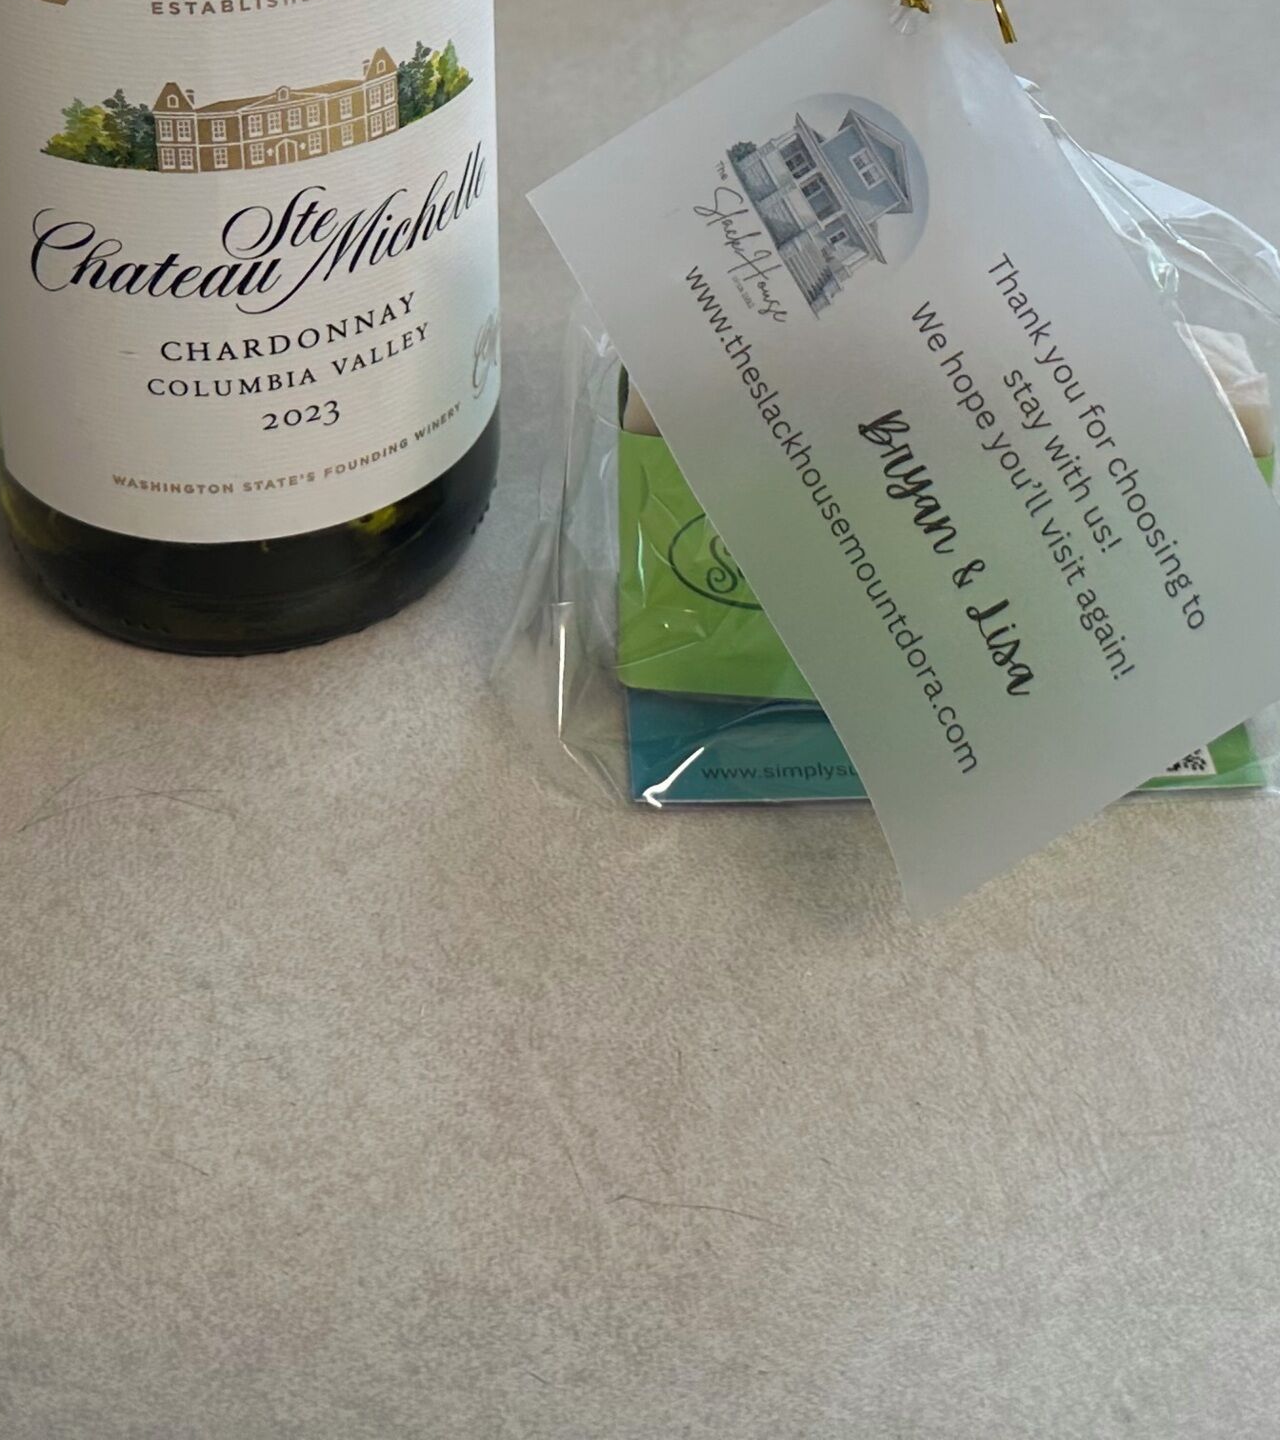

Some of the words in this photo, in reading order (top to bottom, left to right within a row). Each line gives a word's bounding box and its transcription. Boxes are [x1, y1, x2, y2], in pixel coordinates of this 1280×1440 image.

[31, 208, 282, 298] Chateau
[222, 185, 339, 260] Ste
[160, 291, 416, 362] CHARDONNAY
[727, 249, 788, 323] House
[147, 367, 318, 398] COLUMBIA
[331, 322, 430, 376] VALLEY
[111, 473, 235, 495] WASHINGTON
[242, 471, 317, 492] STATE'S
[323, 438, 410, 479] FOUNDING
[413, 401, 462, 442] WINERY
[262, 400, 341, 431] 2023
[988, 252, 1052, 346] Thank
[1034, 345, 1086, 403] you
[1078, 404, 1116, 449] for
[1108, 457, 1192, 598] choosing
[1181, 593, 1205, 630] to
[1003, 369, 1052, 430] stay
[1045, 435, 1092, 503] with
[1083, 506, 1122, 553] us!
[686, 266, 978, 774] www.theslackhousemountdora.com
[858, 409, 957, 554] Bryan
[912, 301, 947, 352] We
[940, 350, 995, 430] hope
[982, 431, 1052, 518] you'll
[1041, 517, 1086, 587] visit
[1076, 588, 1135, 681] again!
[952, 558, 986, 589] &
[966, 599, 1034, 696] Lisa
